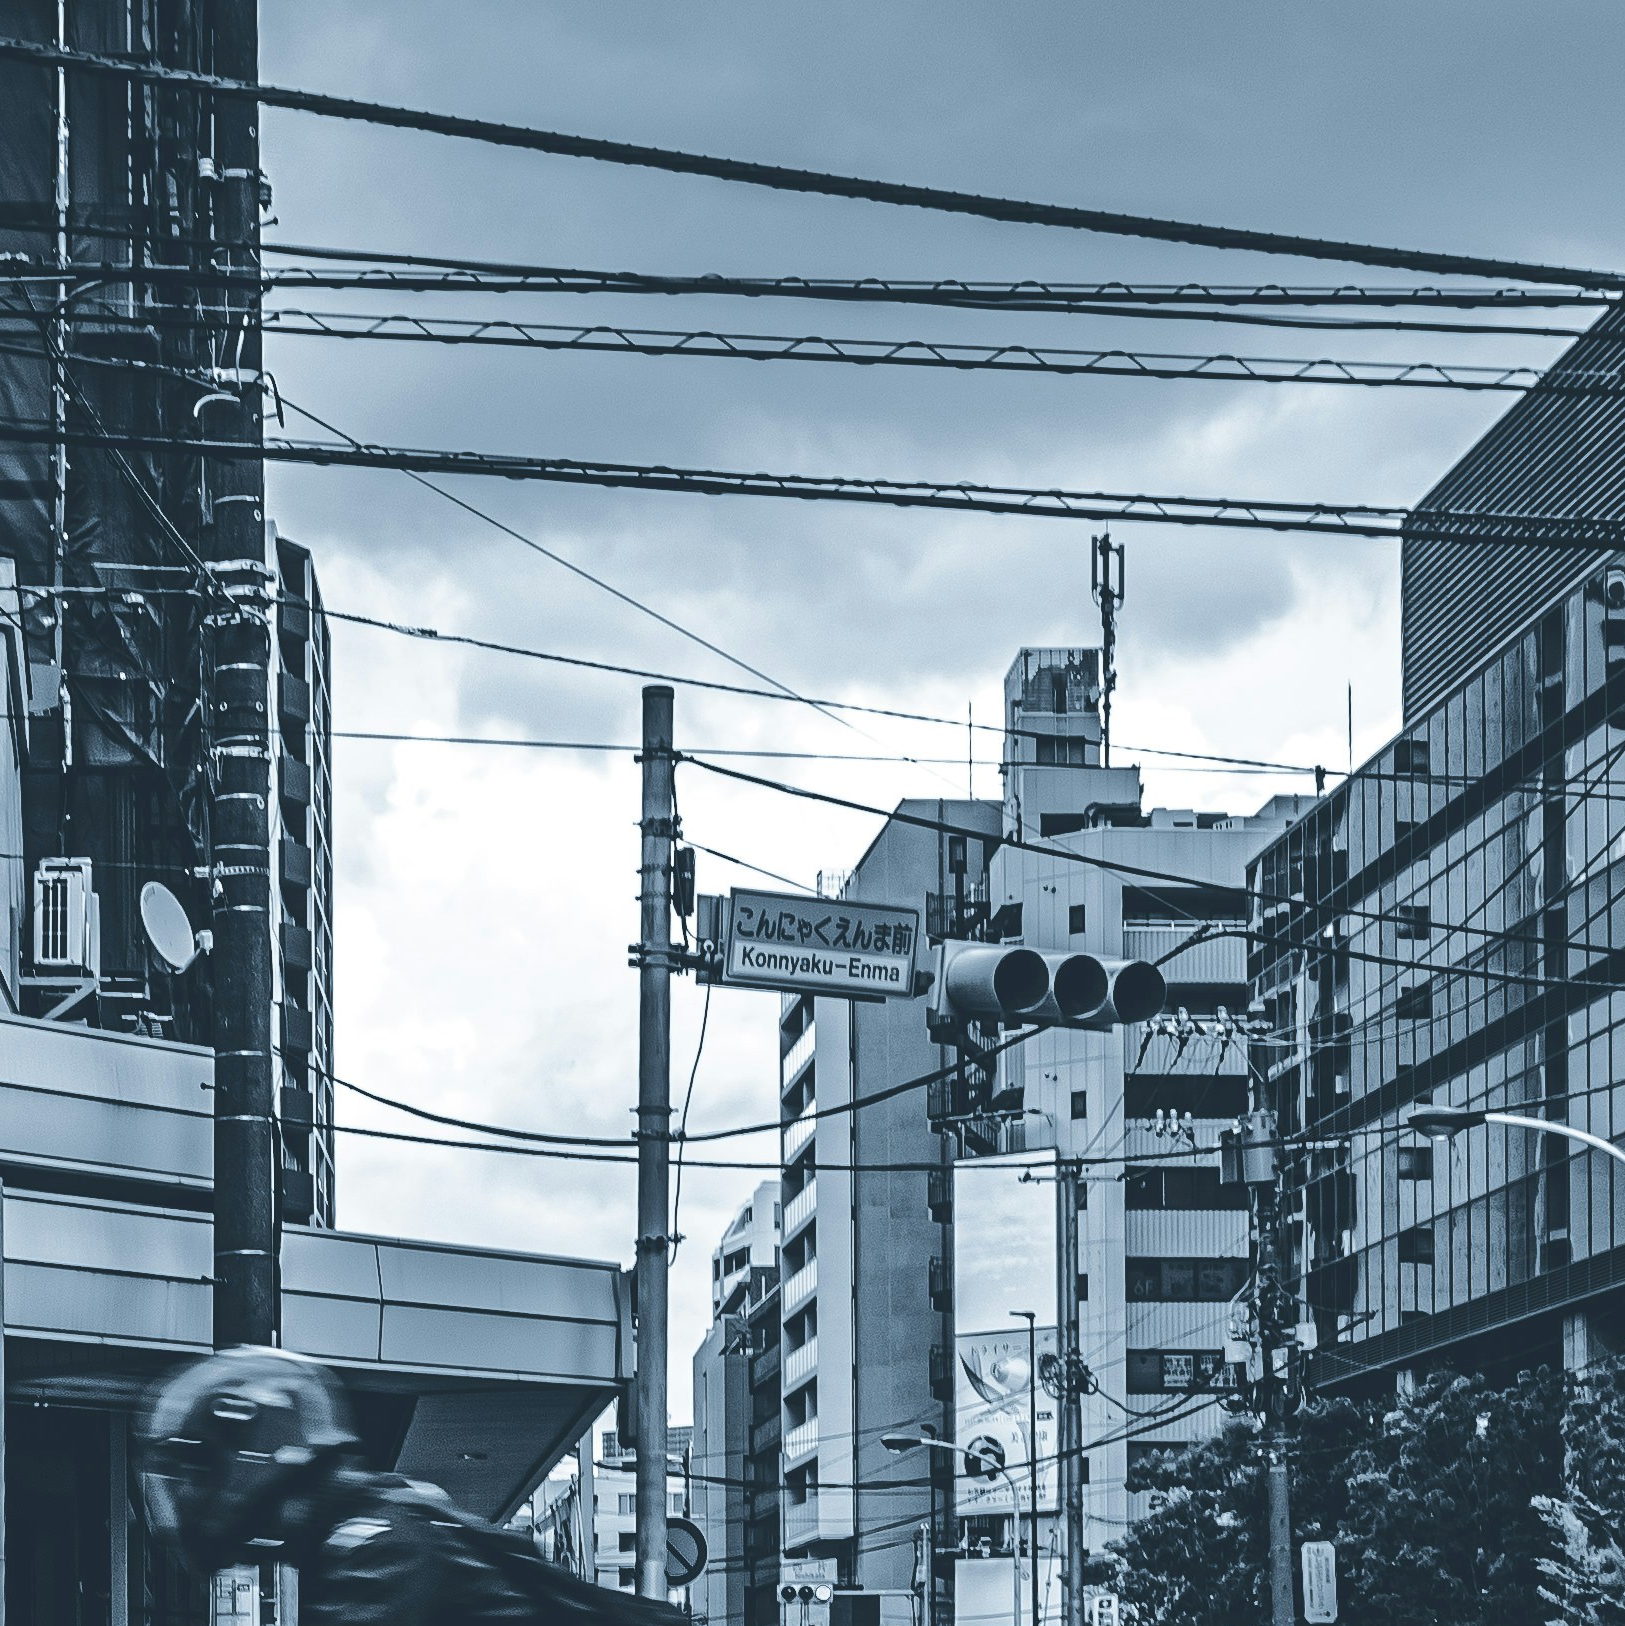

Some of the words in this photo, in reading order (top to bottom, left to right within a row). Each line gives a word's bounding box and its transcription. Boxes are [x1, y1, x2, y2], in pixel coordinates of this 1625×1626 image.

[737, 906, 913, 955] こんにゃくえんま前
[741, 946, 900, 982] Konnyaku-Enma
